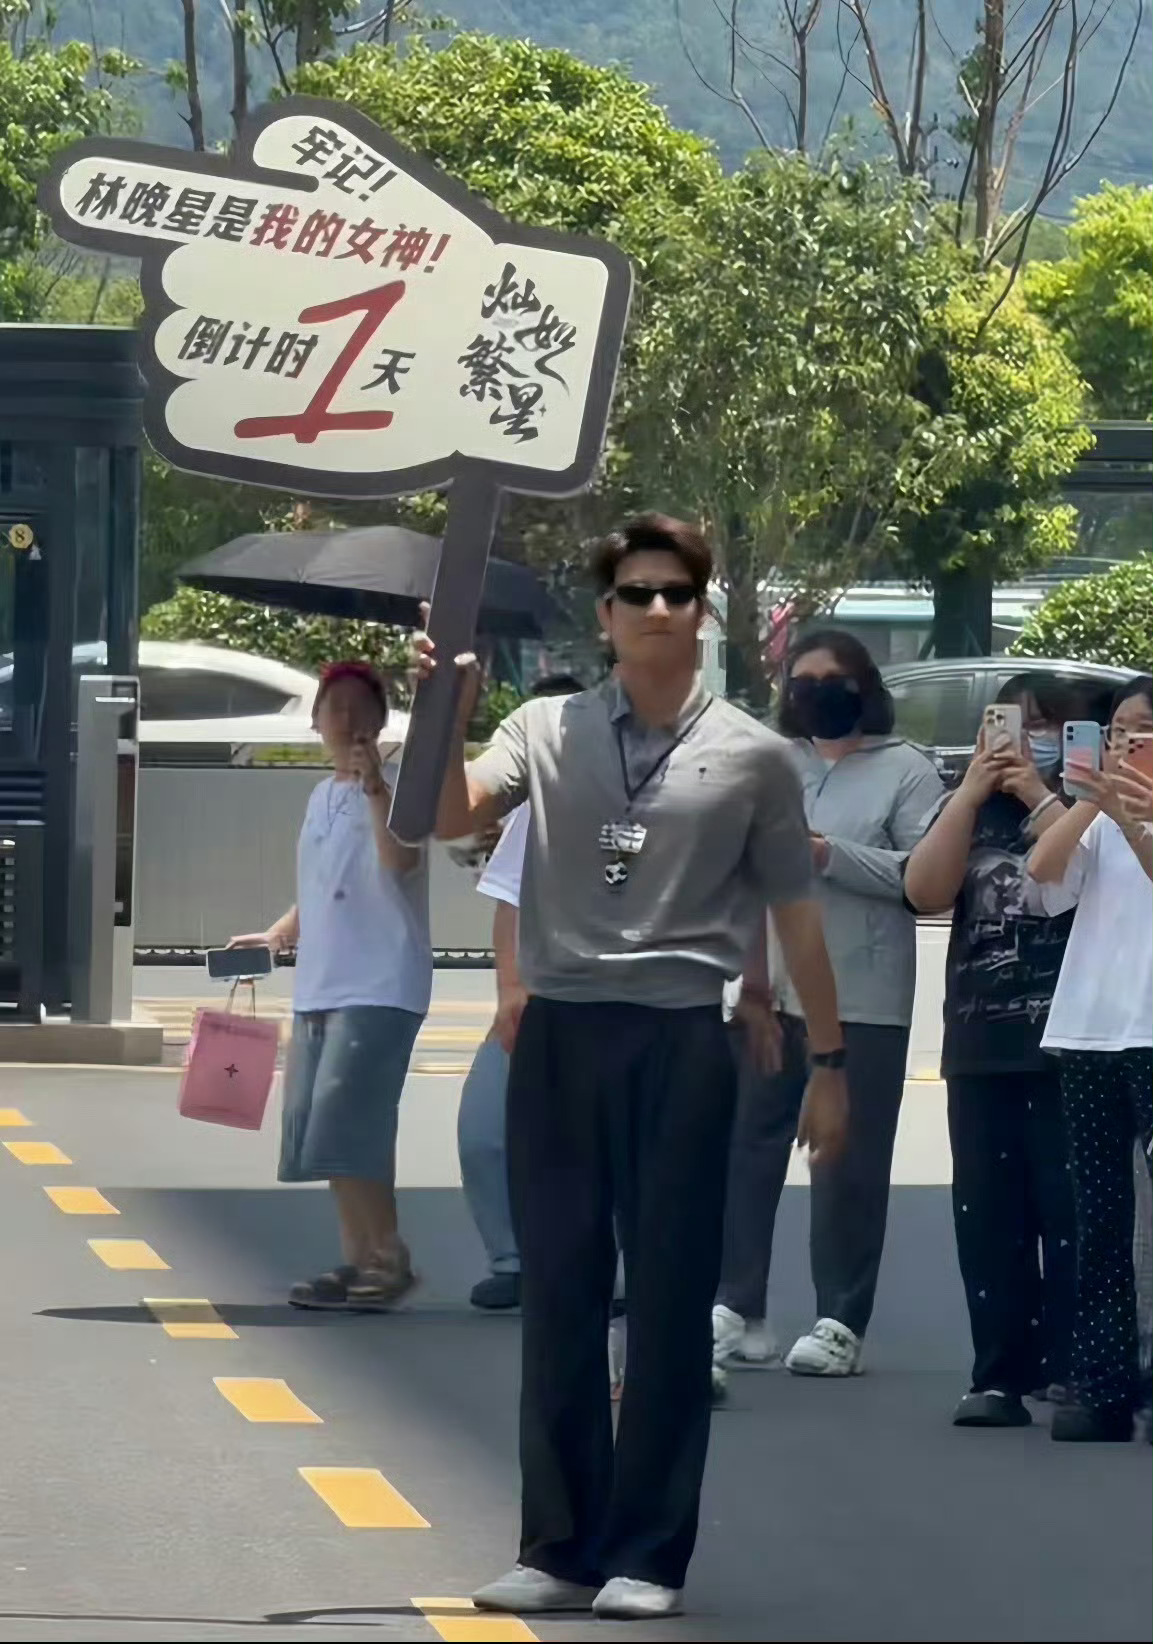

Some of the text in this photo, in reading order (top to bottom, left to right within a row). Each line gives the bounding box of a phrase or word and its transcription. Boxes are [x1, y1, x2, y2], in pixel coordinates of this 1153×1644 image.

[291, 125, 398, 202] 牢记!
[74, 171, 452, 275] 林晚星是我的女神!
